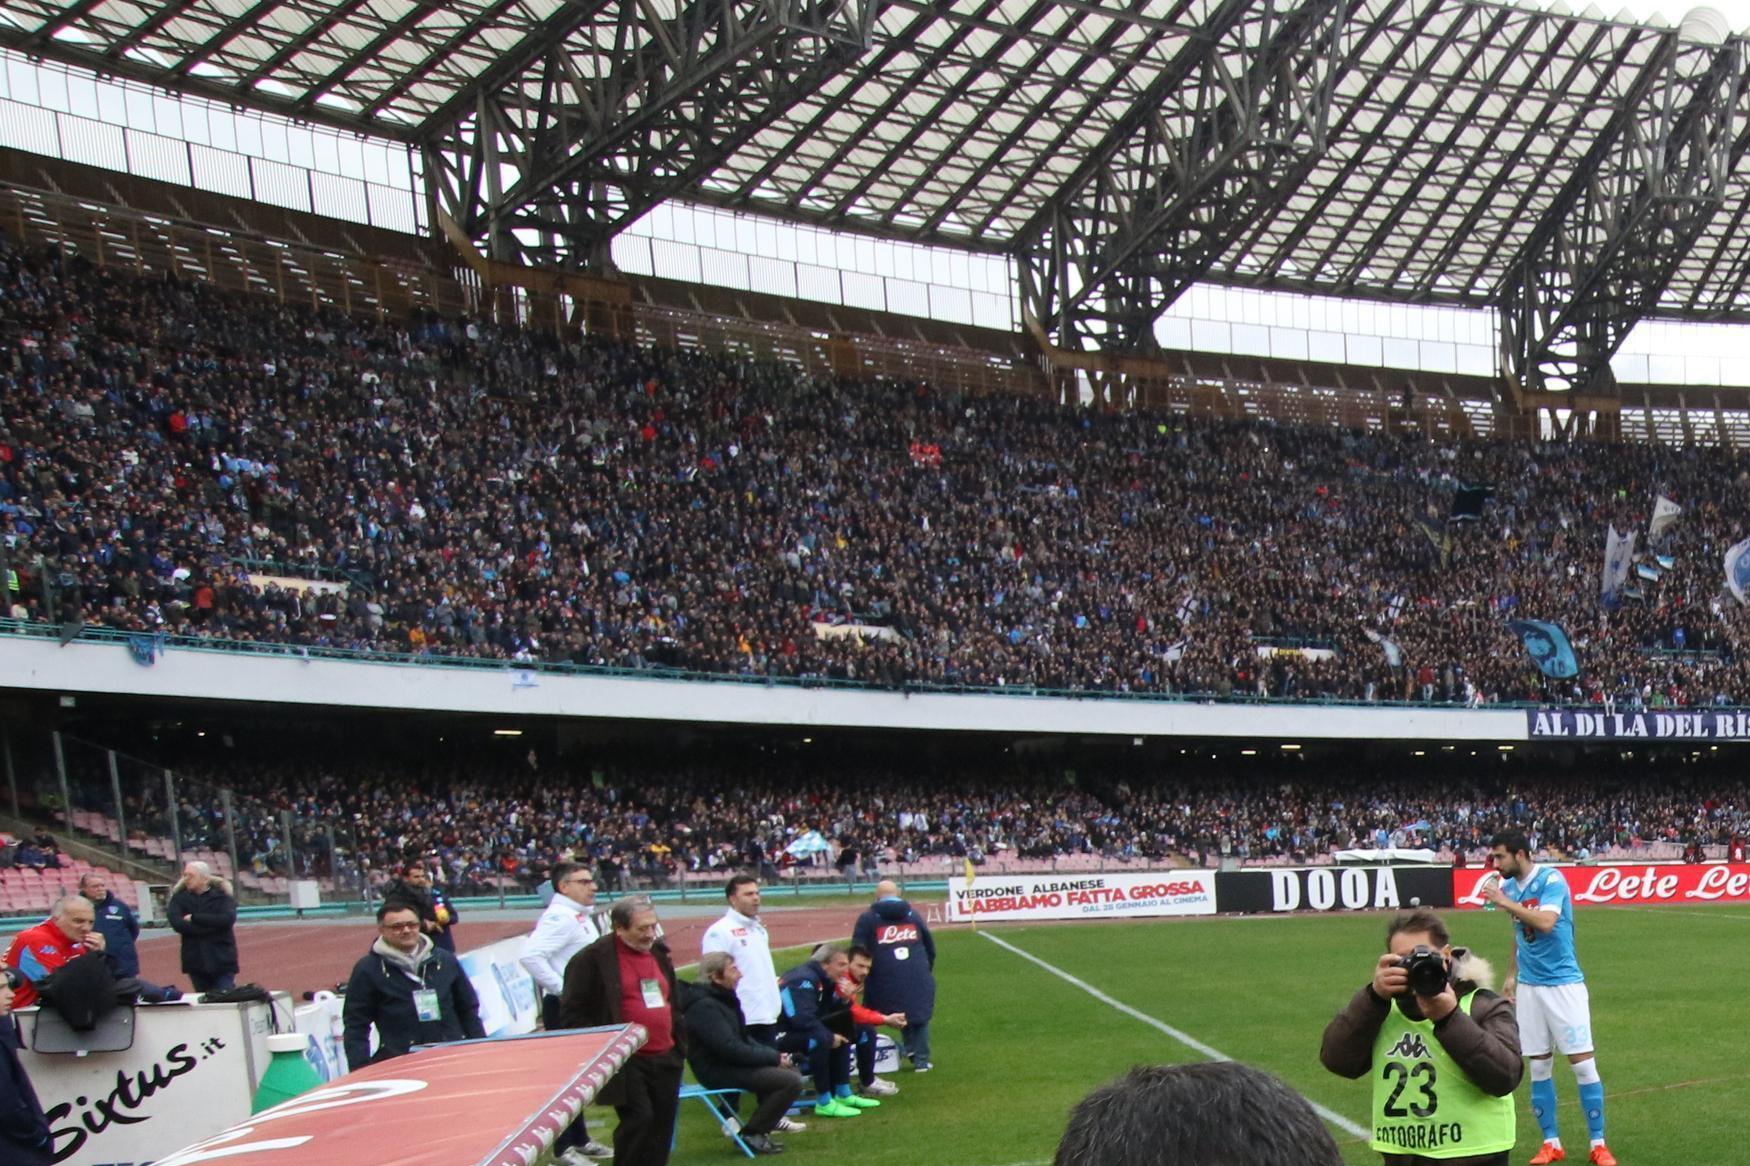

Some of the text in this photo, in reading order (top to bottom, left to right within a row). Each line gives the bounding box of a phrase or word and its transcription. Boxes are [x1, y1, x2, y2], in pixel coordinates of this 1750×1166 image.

[1532, 712, 1568, 735] AL
[1575, 713, 1606, 737] DI
[1614, 714, 1648, 737] LA
[1655, 714, 1708, 738] DEL
[957, 879, 1104, 899] VERDONE ALBANESE
[958, 880, 1205, 915] L'ABBIAMO FATTA GROSSA
[1271, 867, 1400, 911] DOOA
[1575, 867, 1678, 902] Lete
[1082, 905, 1101, 913] DAL
[1115, 900, 1158, 911] GENNAIO
[1160, 899, 1172, 907] AL
[1173, 895, 1208, 905] CINEMA
[878, 925, 917, 944] Lete
[1382, 1061, 1438, 1118] 23
